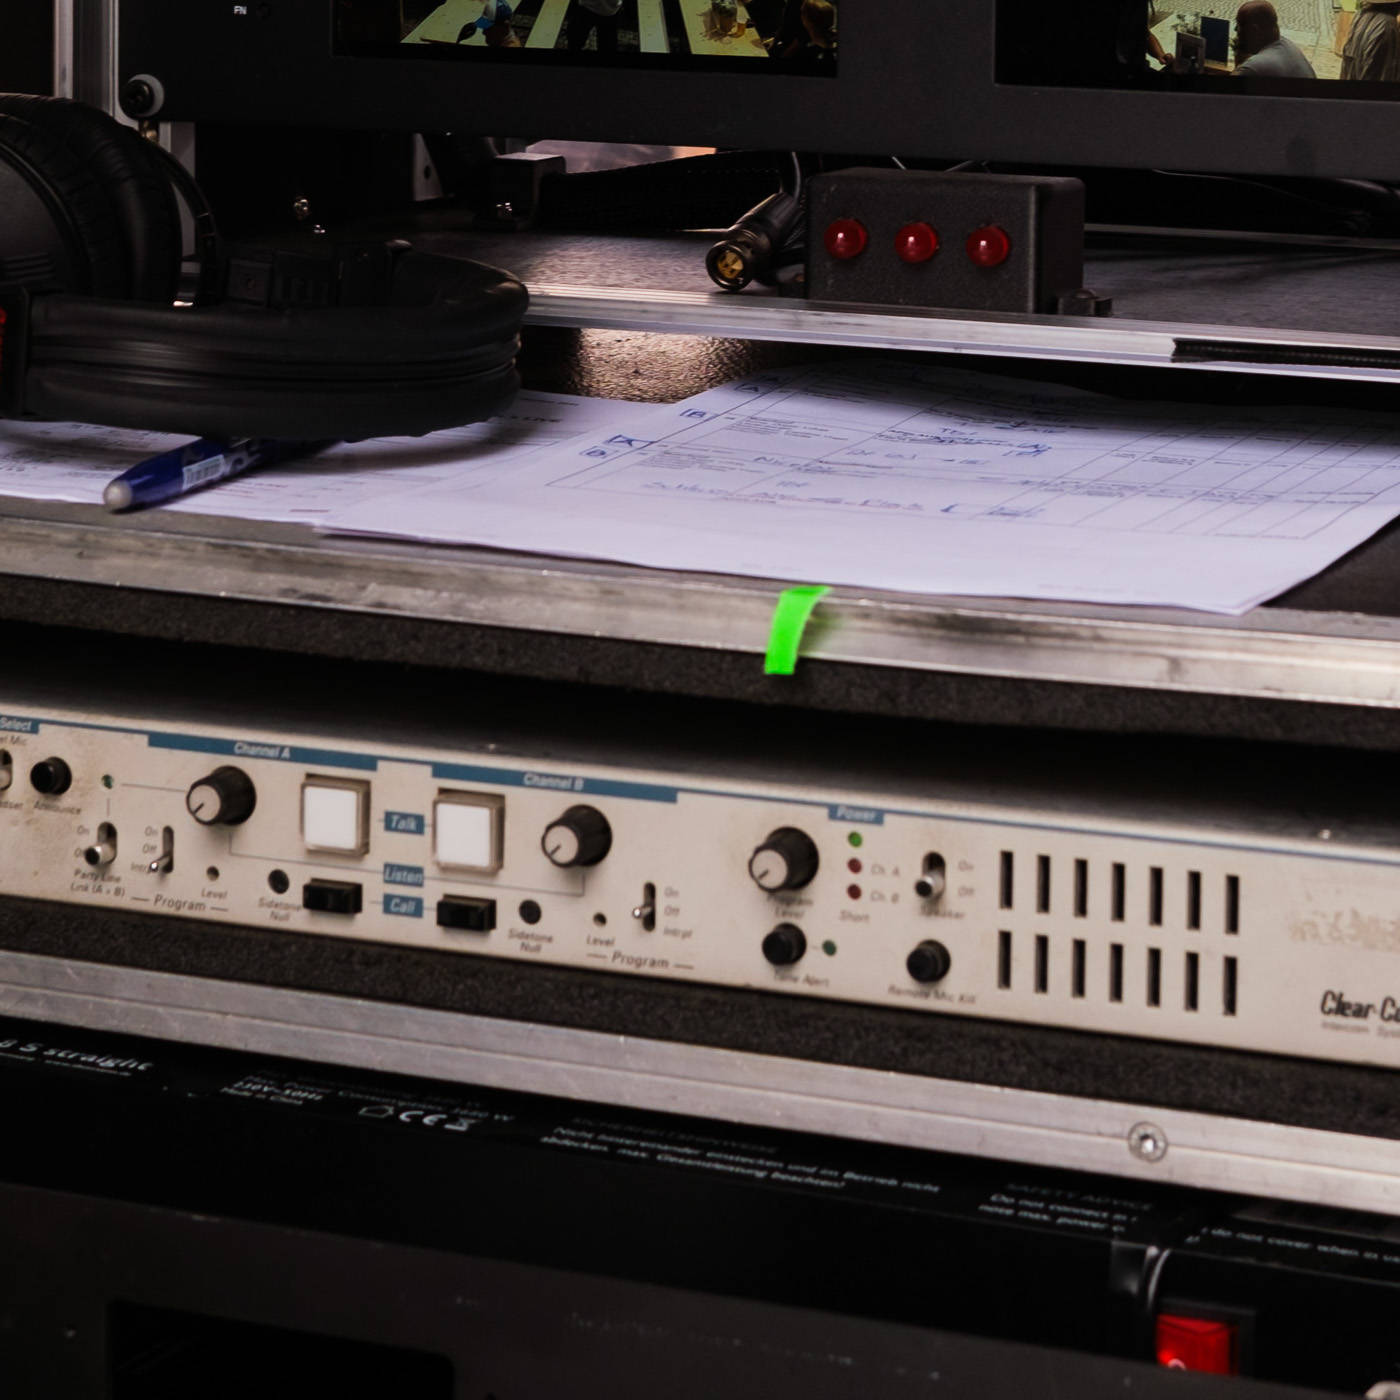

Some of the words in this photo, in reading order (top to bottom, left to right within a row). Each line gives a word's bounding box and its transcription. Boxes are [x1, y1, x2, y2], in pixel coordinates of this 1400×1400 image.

[233, 5, 247, 16] FN
[0, 717, 32, 731] Select
[7, 734, 28, 747] Mic
[234, 742, 279, 758] Channel
[280, 746, 291, 760] A
[523, 772, 571, 790] Channel
[574, 777, 584, 791] B
[33, 799, 82, 816] Announce
[836, 806, 877, 823] Power
[390, 815, 418, 831] Talk
[385, 865, 424, 883] Listen
[201, 887, 228, 900] Level
[154, 894, 206, 912] Program
[390, 898, 416, 913] Call
[840, 910, 870, 923] Short
[508, 928, 553, 944] Sidetone
[586, 934, 615, 947] Level
[520, 941, 541, 953] Null
[611, 951, 669, 969] Program
[887, 984, 931, 999] Remote
[934, 990, 955, 1004] Mic
[44, 1044, 154, 1072] straight
[1004, 1180, 1077, 1200] SAFETY
[1079, 1192, 1155, 1212] ADVICE
[989, 1191, 1015, 1205] Do
[1017, 1197, 1045, 1209] not
[1047, 1202, 1109, 1219] connect
[1209, 1226, 1233, 1239] do
[1235, 1230, 1262, 1243] not
[1266, 1235, 1312, 1251] cover
[1316, 1241, 1359, 1258] when
